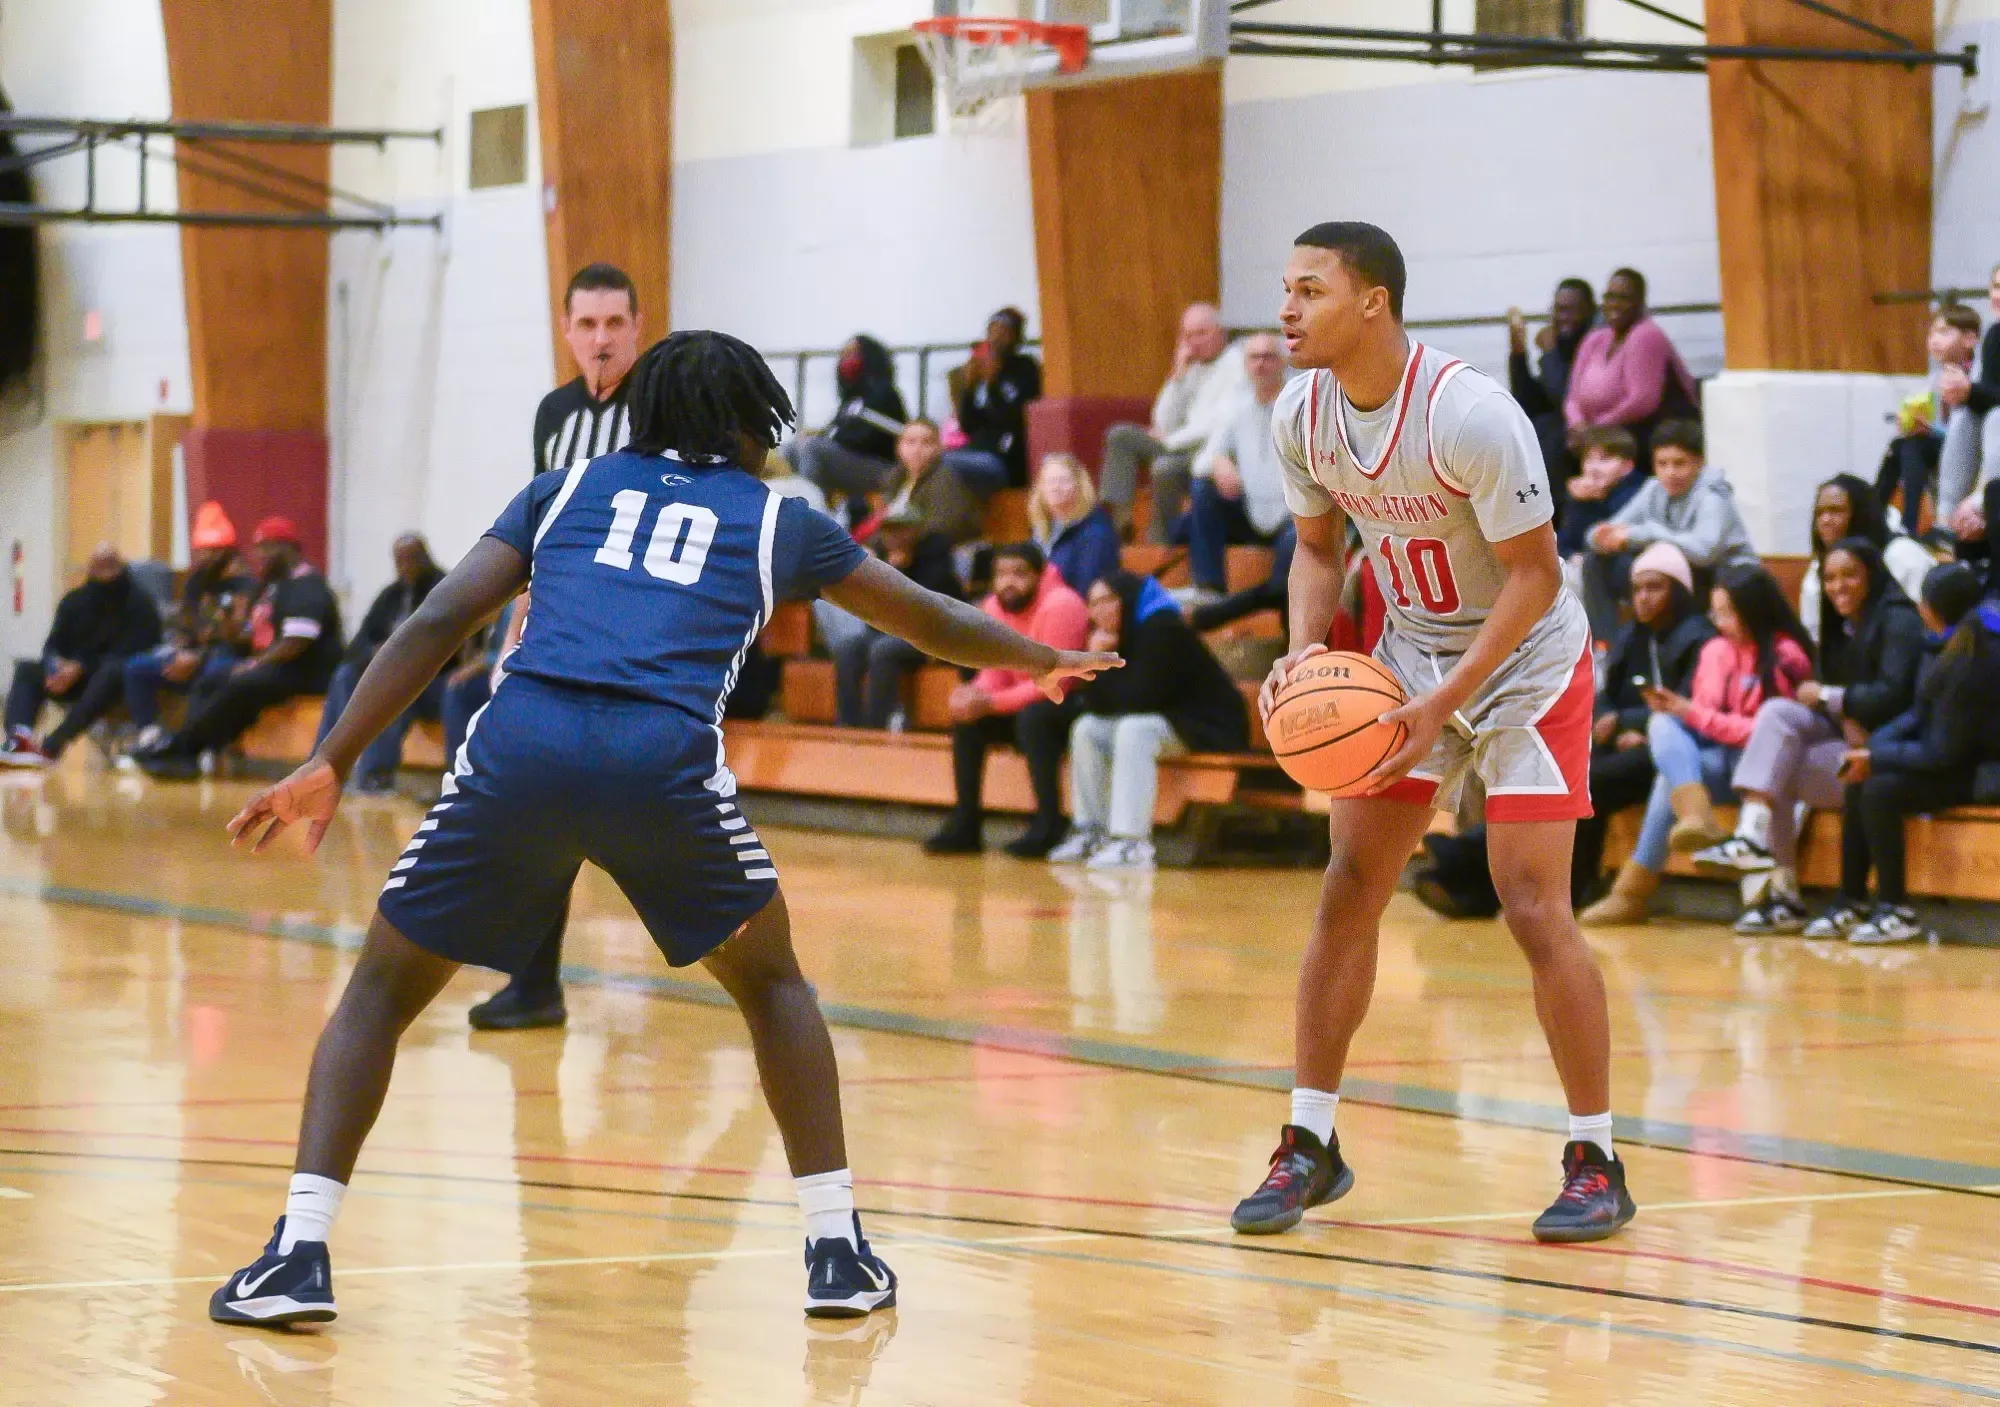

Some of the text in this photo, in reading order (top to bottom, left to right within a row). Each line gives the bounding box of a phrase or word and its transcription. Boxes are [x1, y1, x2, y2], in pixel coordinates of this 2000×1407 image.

[594, 489, 719, 585] 10
[1380, 492, 1450, 523] ATHYN
[1380, 535, 1461, 615] 10
